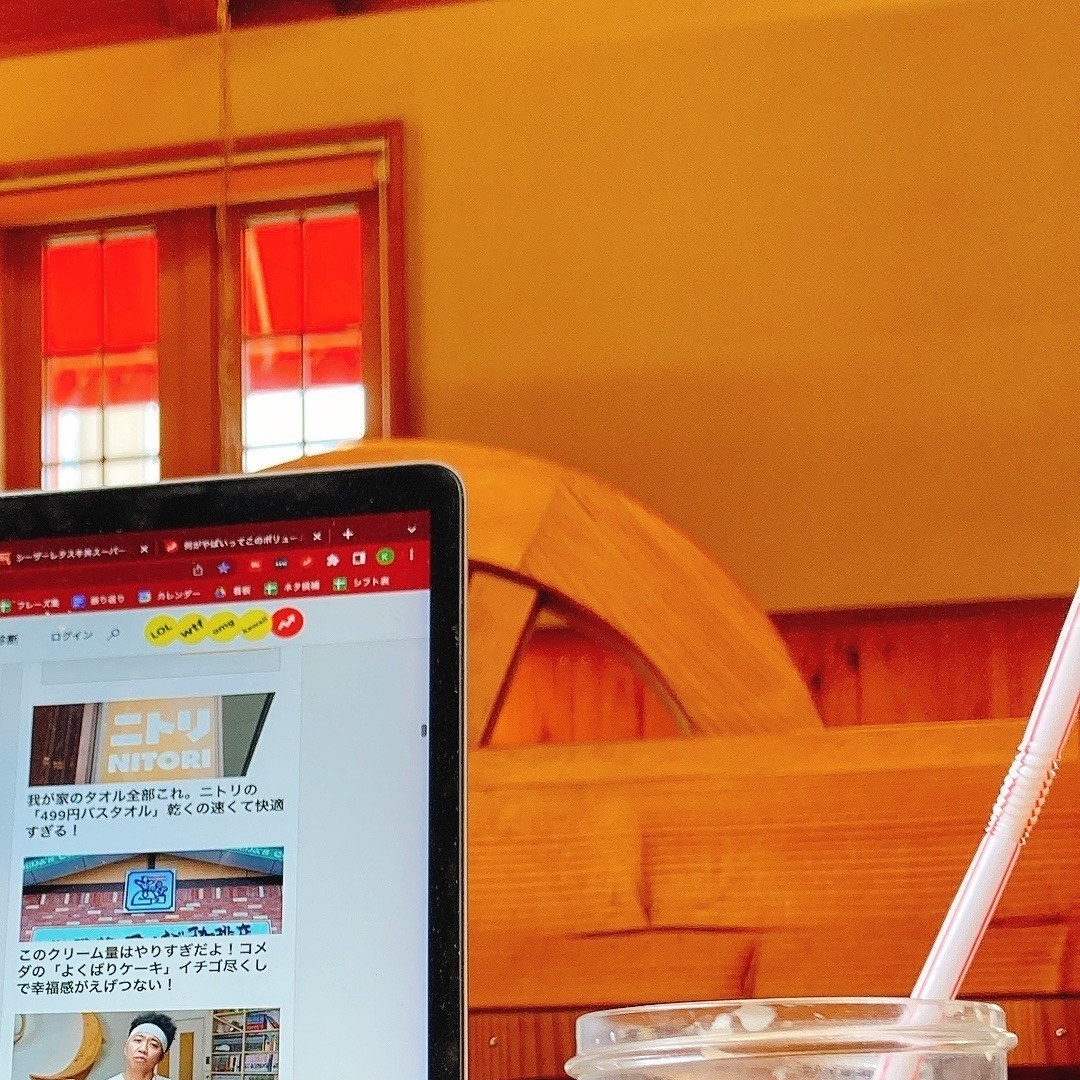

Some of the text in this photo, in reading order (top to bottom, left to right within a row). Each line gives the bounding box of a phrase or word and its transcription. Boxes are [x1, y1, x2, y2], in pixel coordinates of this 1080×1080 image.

[157, 588, 201, 601] カレンダー
[51, 630, 94, 643] ログイン
[150, 624, 173, 640] LOL
[180, 619, 205, 638] wtf
[212, 619, 235, 636] omg
[110, 709, 211, 747] ニトリ
[107, 749, 212, 774] NITORI
[28, 784, 258, 807] 我が家のタオル全部これ。ニトリの
[32, 798, 285, 822] 「499円バスタオル」乾くの速くて快適
[26, 824, 78, 838] すぎる！
[19, 942, 267, 963] このクリーム量はやりすぎだよ！コメ
[18, 958, 267, 978] ダの「よくばりケーキ」イチゴ尽くし
[18, 977, 173, 995] で幸福感がえげつない！
